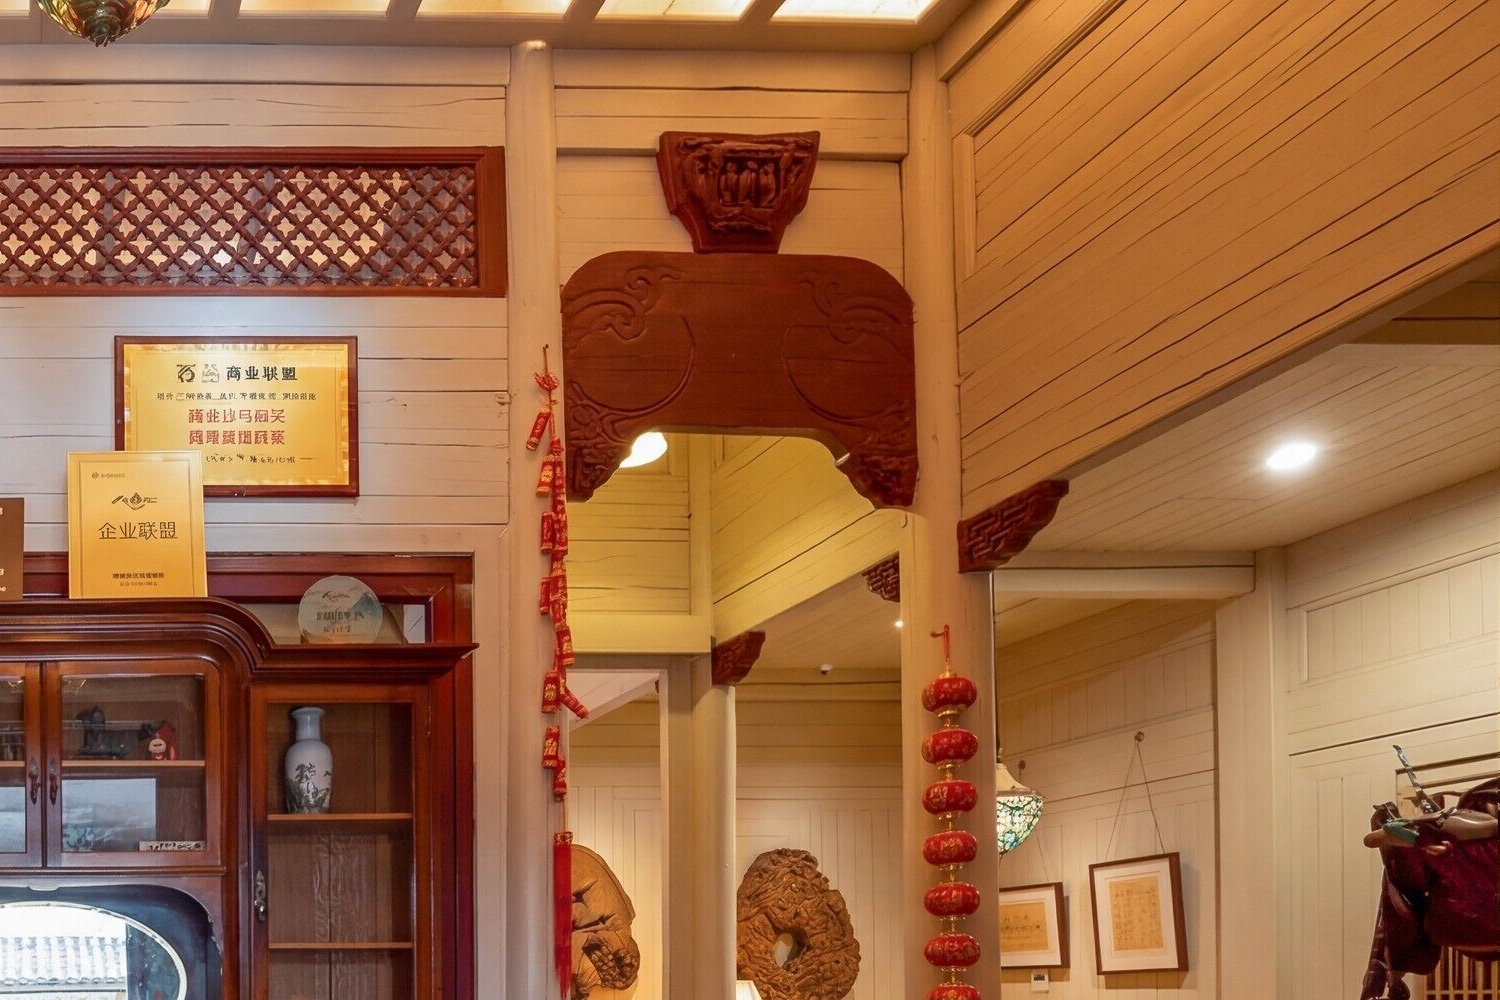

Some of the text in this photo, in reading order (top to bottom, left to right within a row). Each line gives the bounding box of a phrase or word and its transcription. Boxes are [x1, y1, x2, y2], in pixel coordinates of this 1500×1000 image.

[226, 365, 298, 382] 商业联盟
[98, 521, 178, 540] 企业联盟
